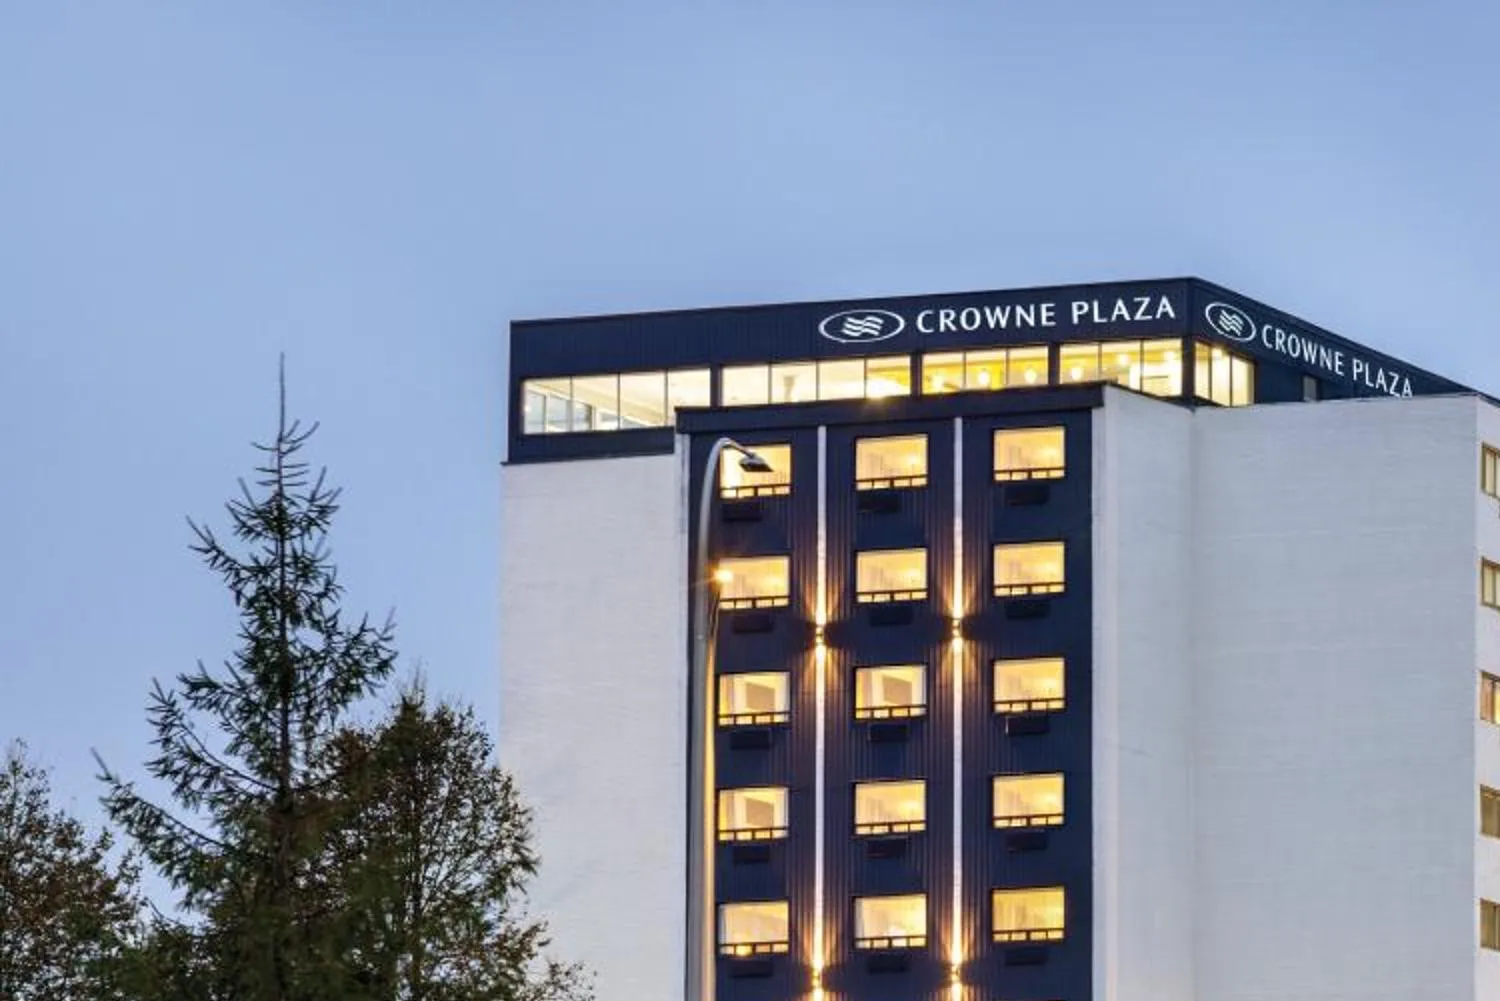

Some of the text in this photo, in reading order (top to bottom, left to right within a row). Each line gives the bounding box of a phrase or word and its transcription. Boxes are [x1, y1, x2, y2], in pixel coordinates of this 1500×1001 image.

[916, 295, 1175, 333] CROWNE PLAZA
[1262, 324, 1413, 397] CROWNE PLAZA
